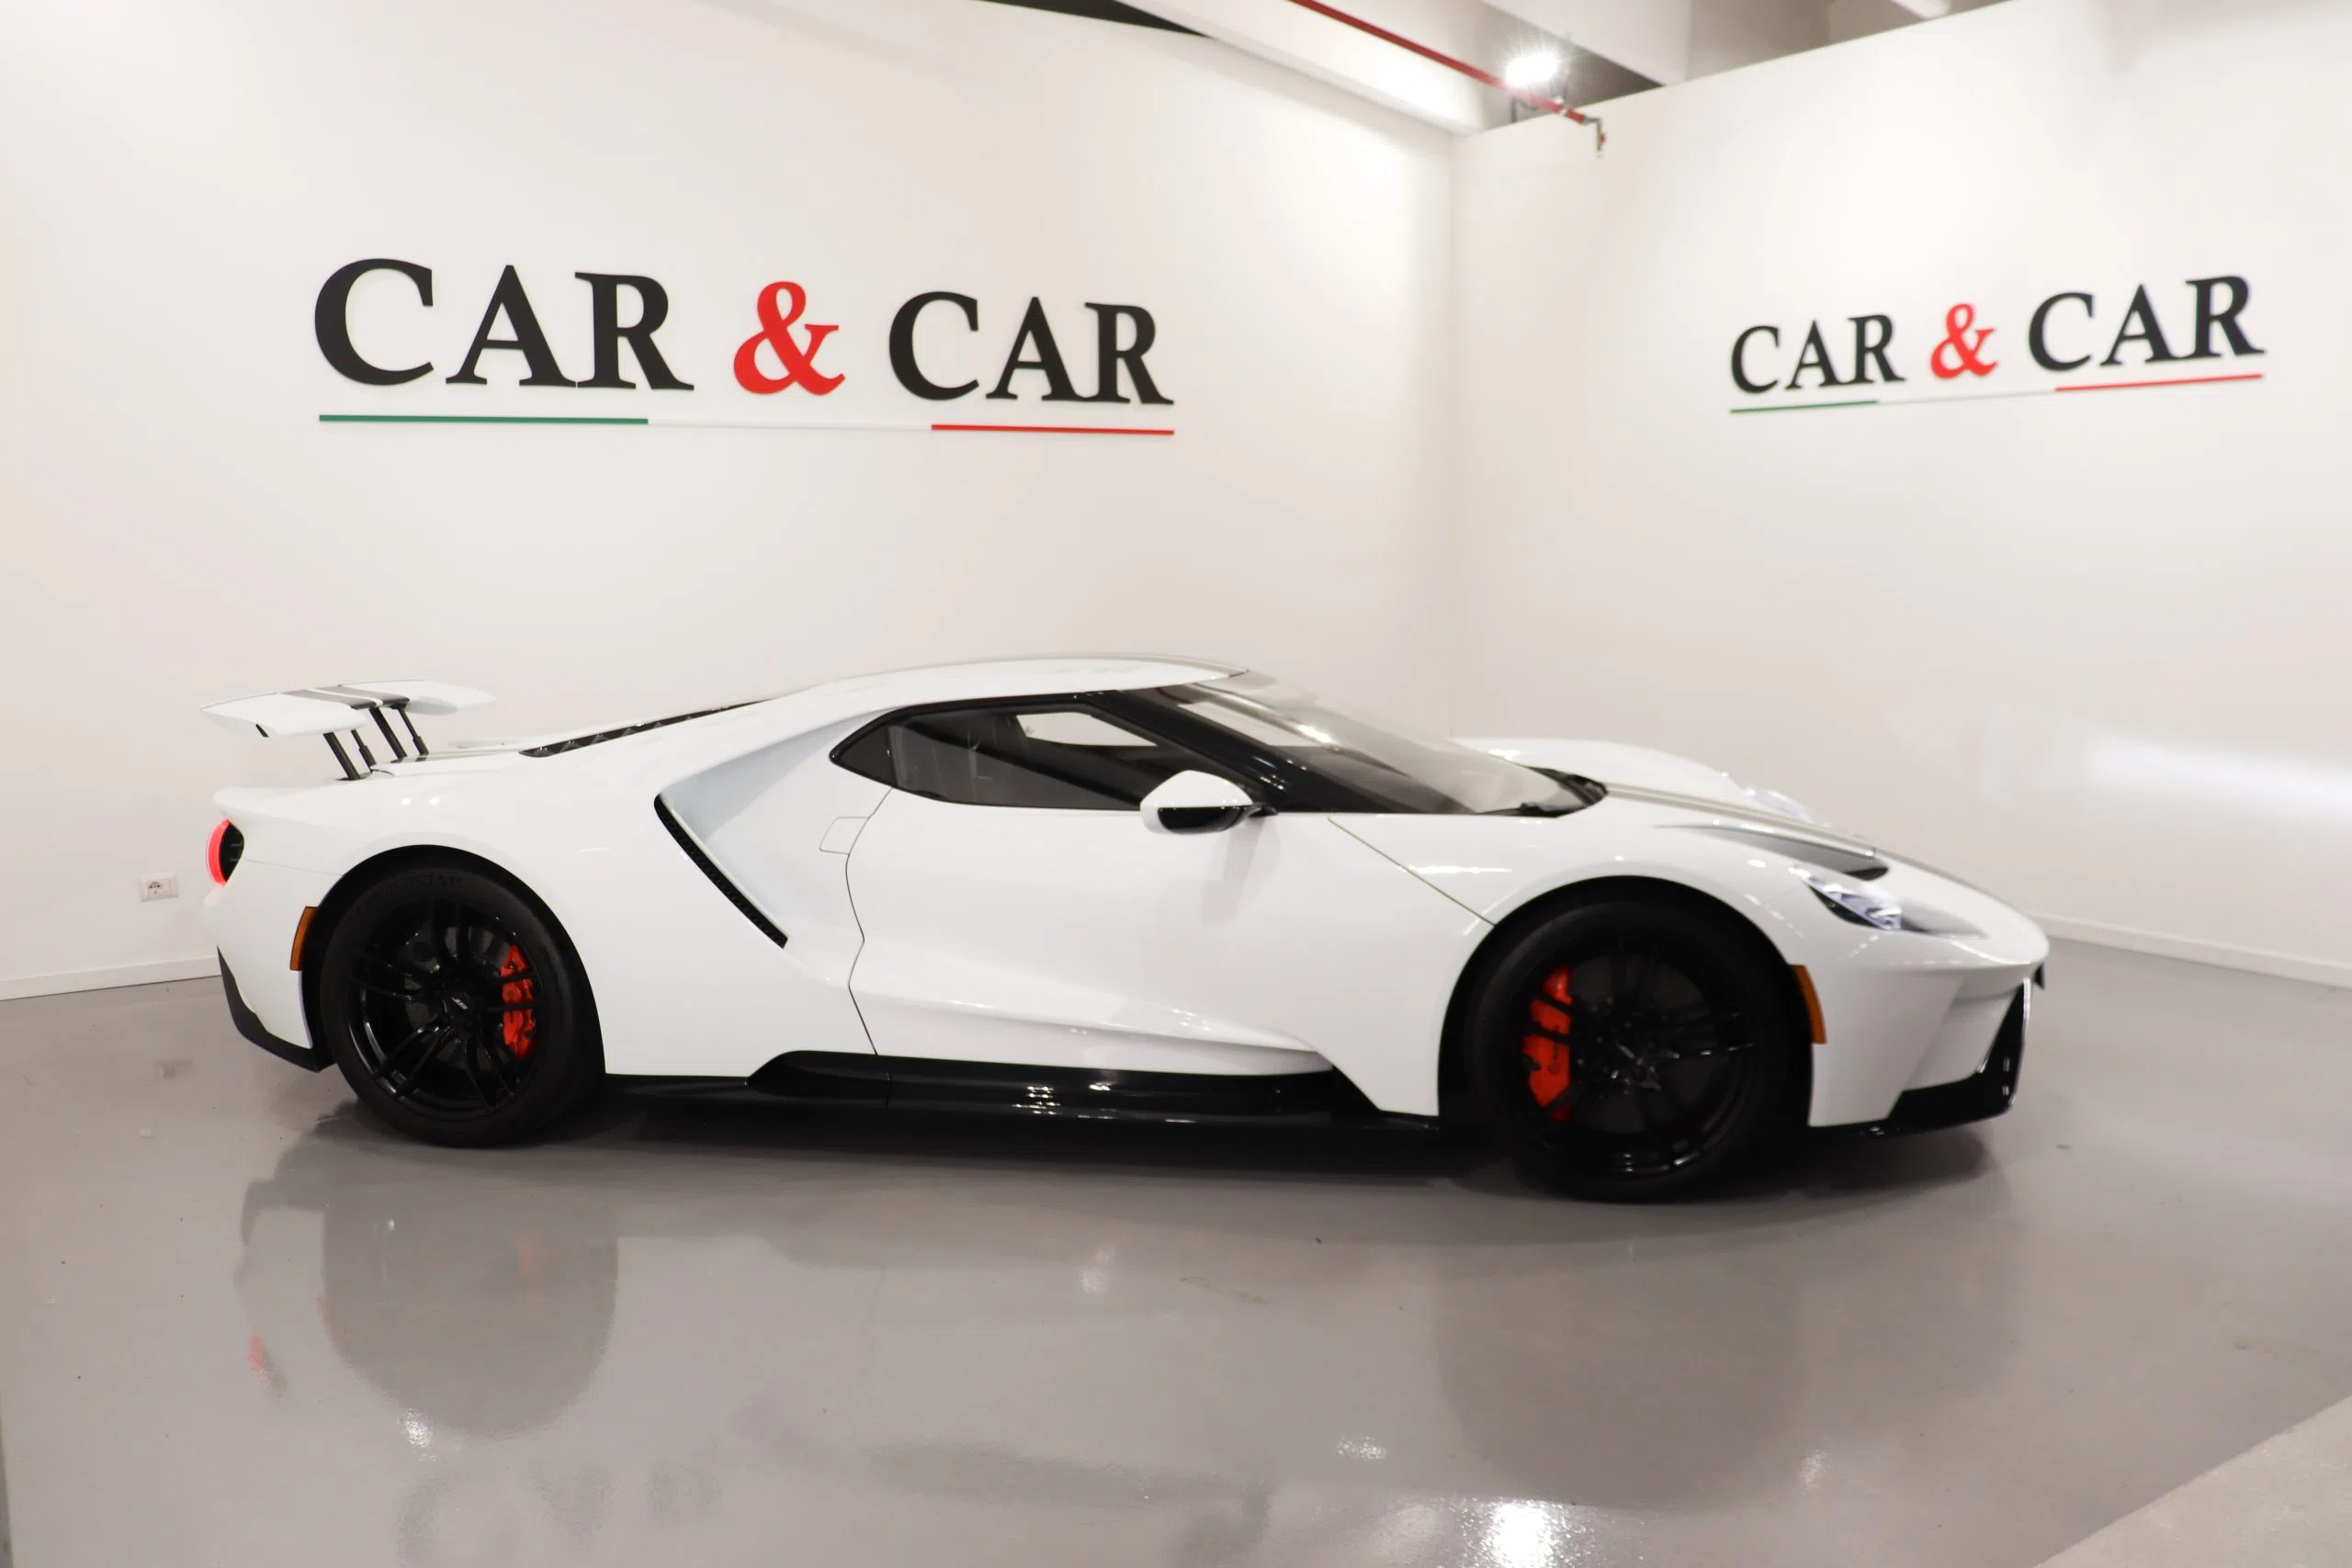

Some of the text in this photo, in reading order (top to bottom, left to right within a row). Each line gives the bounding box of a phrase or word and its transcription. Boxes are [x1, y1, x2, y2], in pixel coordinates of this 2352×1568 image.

[314, 258, 1175, 406] CAR & CAR
[1731, 275, 2266, 394] CAR & CAR
